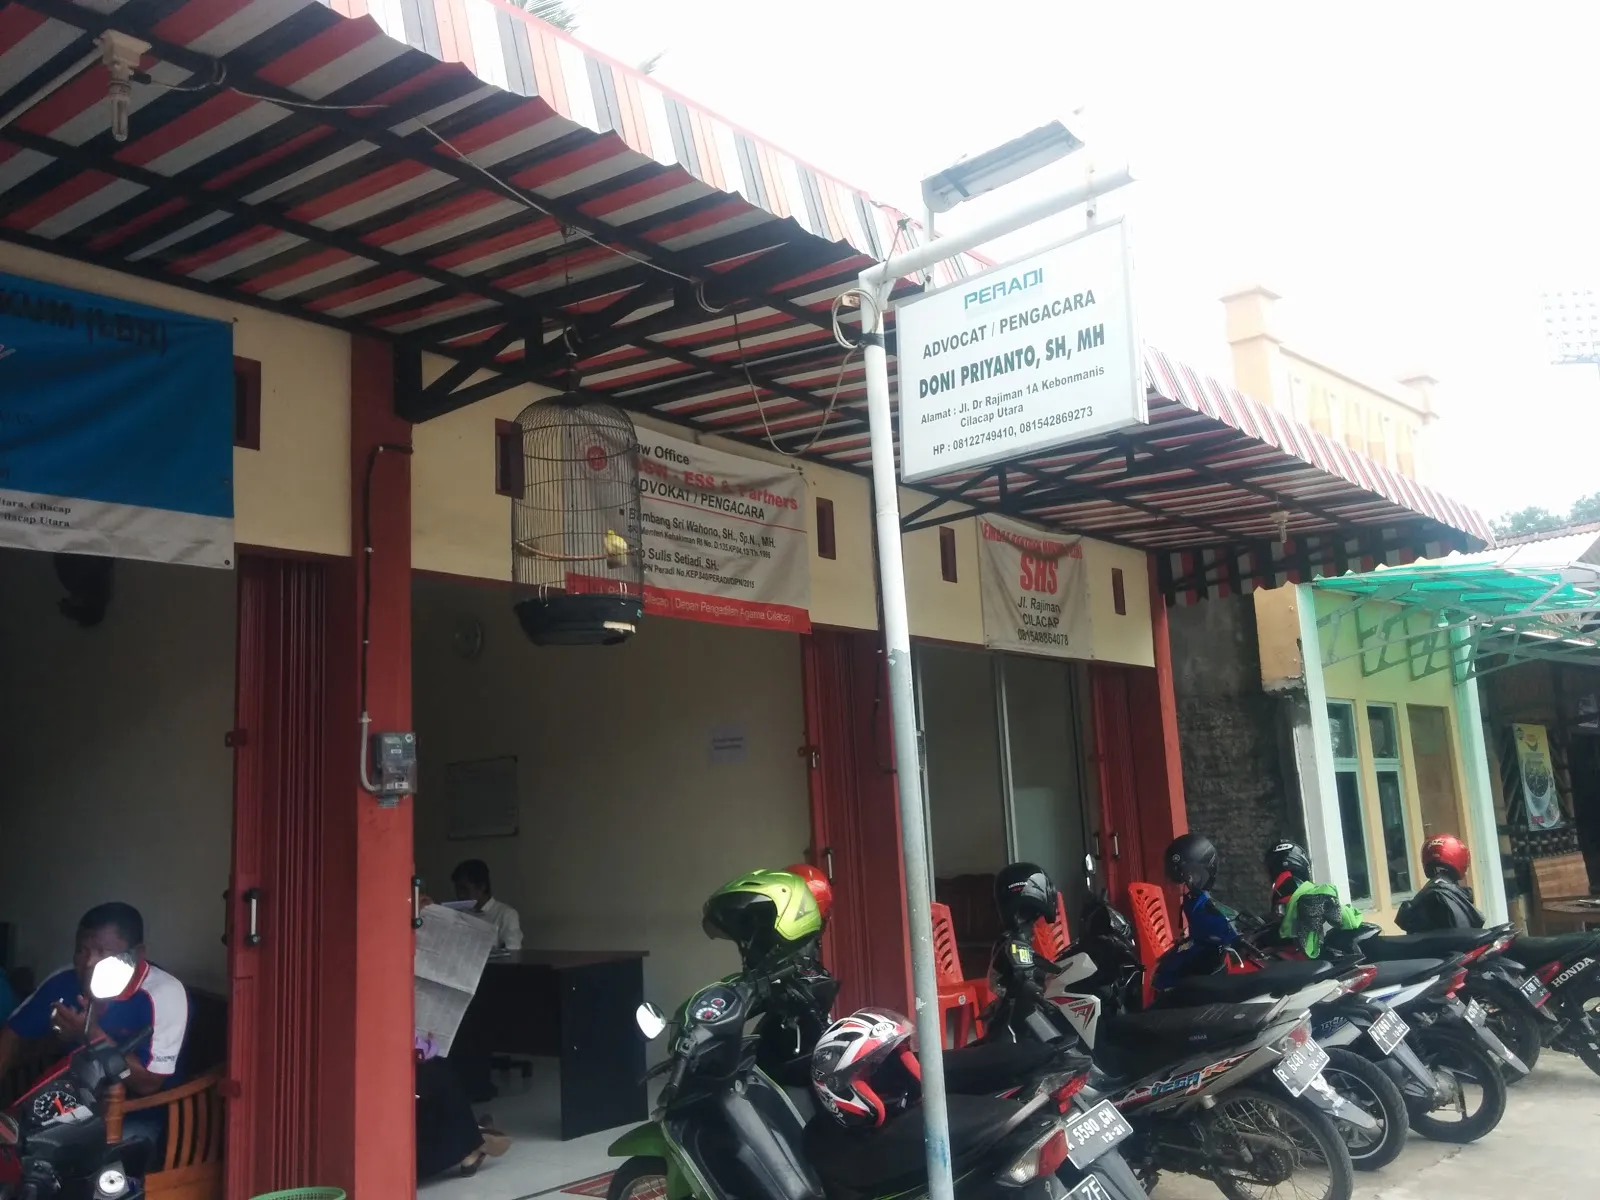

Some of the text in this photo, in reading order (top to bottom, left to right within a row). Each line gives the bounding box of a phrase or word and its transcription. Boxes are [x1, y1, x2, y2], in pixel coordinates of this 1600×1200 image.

[964, 268, 1043, 309] PERADI
[923, 325, 987, 359] ADVOCAT
[1000, 289, 1096, 335] PENGACARA
[919, 323, 1105, 399] DONI PRIYANTO, SH, MH
[921, 407, 952, 425] Alamat
[959, 401, 970, 414] Jl.
[972, 399, 983, 411] Dr
[985, 388, 1023, 408] Rajiman
[1026, 379, 1039, 395] 1A
[1042, 365, 1105, 391] Kebonmanis
[960, 403, 1024, 428] Cilacap Utara
[933, 443, 946, 455] HP
[953, 425, 1017, 451] 08122749410,
[1019, 406, 1093, 434] 081542869273
[654, 446, 690, 465] Office
[683, 470, 715, 489] ESS
[700, 493, 765, 520] PENGACARA
[40, 516, 70, 528] Utara
[673, 517, 684, 531] Sri
[686, 520, 721, 540] Wahono,
[648, 547, 672, 562] Sulis
[654, 564, 675, 576] Peradi
[1019, 551, 1059, 595] SHS
[1018, 596, 1062, 615] Jl. Rajiman
[1022, 613, 1060, 630] CILACAP
[1551, 956, 1596, 988] HONDA
[1277, 1069, 1290, 1082] R
[1072, 1117, 1100, 1142] 5590
